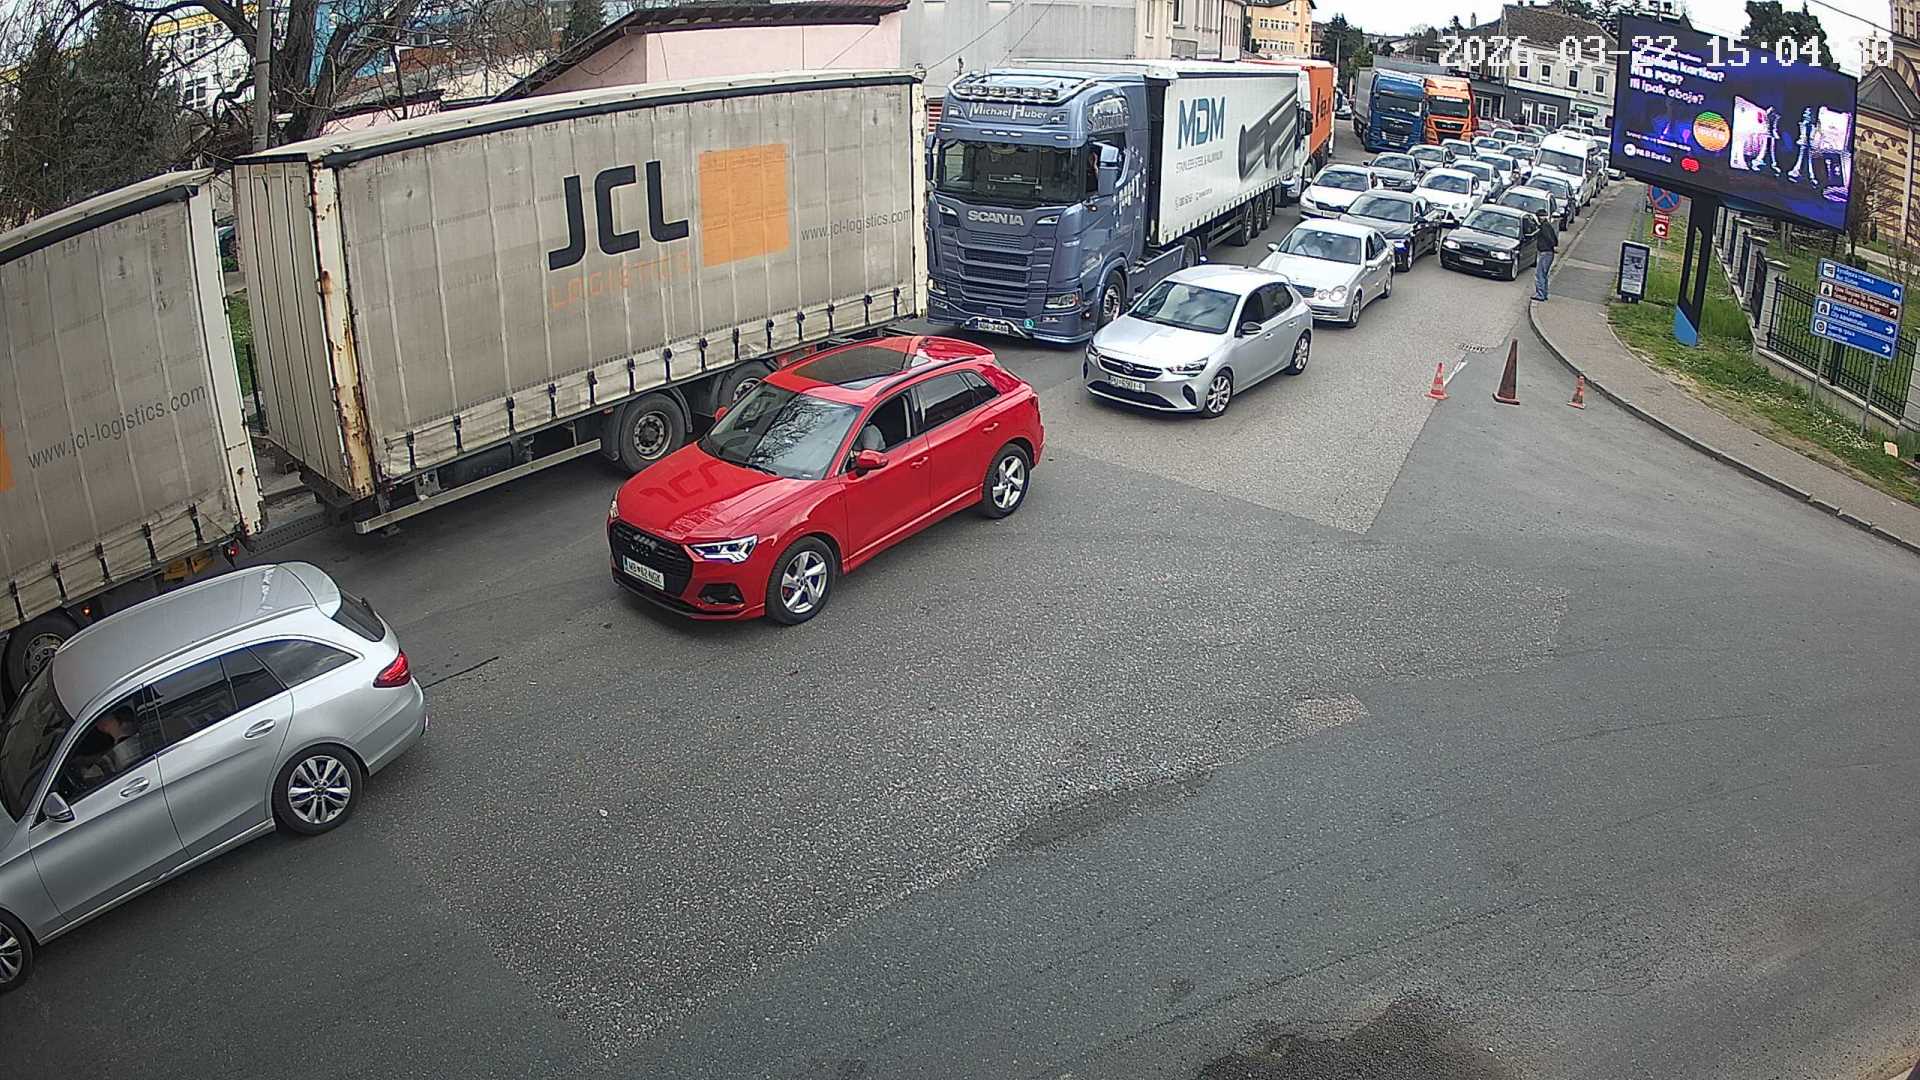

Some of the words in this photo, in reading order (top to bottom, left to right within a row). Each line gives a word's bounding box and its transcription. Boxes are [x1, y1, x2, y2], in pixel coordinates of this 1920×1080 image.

[969, 102, 1011, 118] Michael
[1012, 104, 1047, 120] Huber
[1177, 96, 1226, 150] MDM
[548, 160, 690, 271] JCL
[801, 206, 912, 242] www.jcl-logistics.com
[967, 209, 1025, 226] SCANIA
[1655, 224, 1666, 236] C
[27, 384, 207, 470] www.jcl-logistics.com
